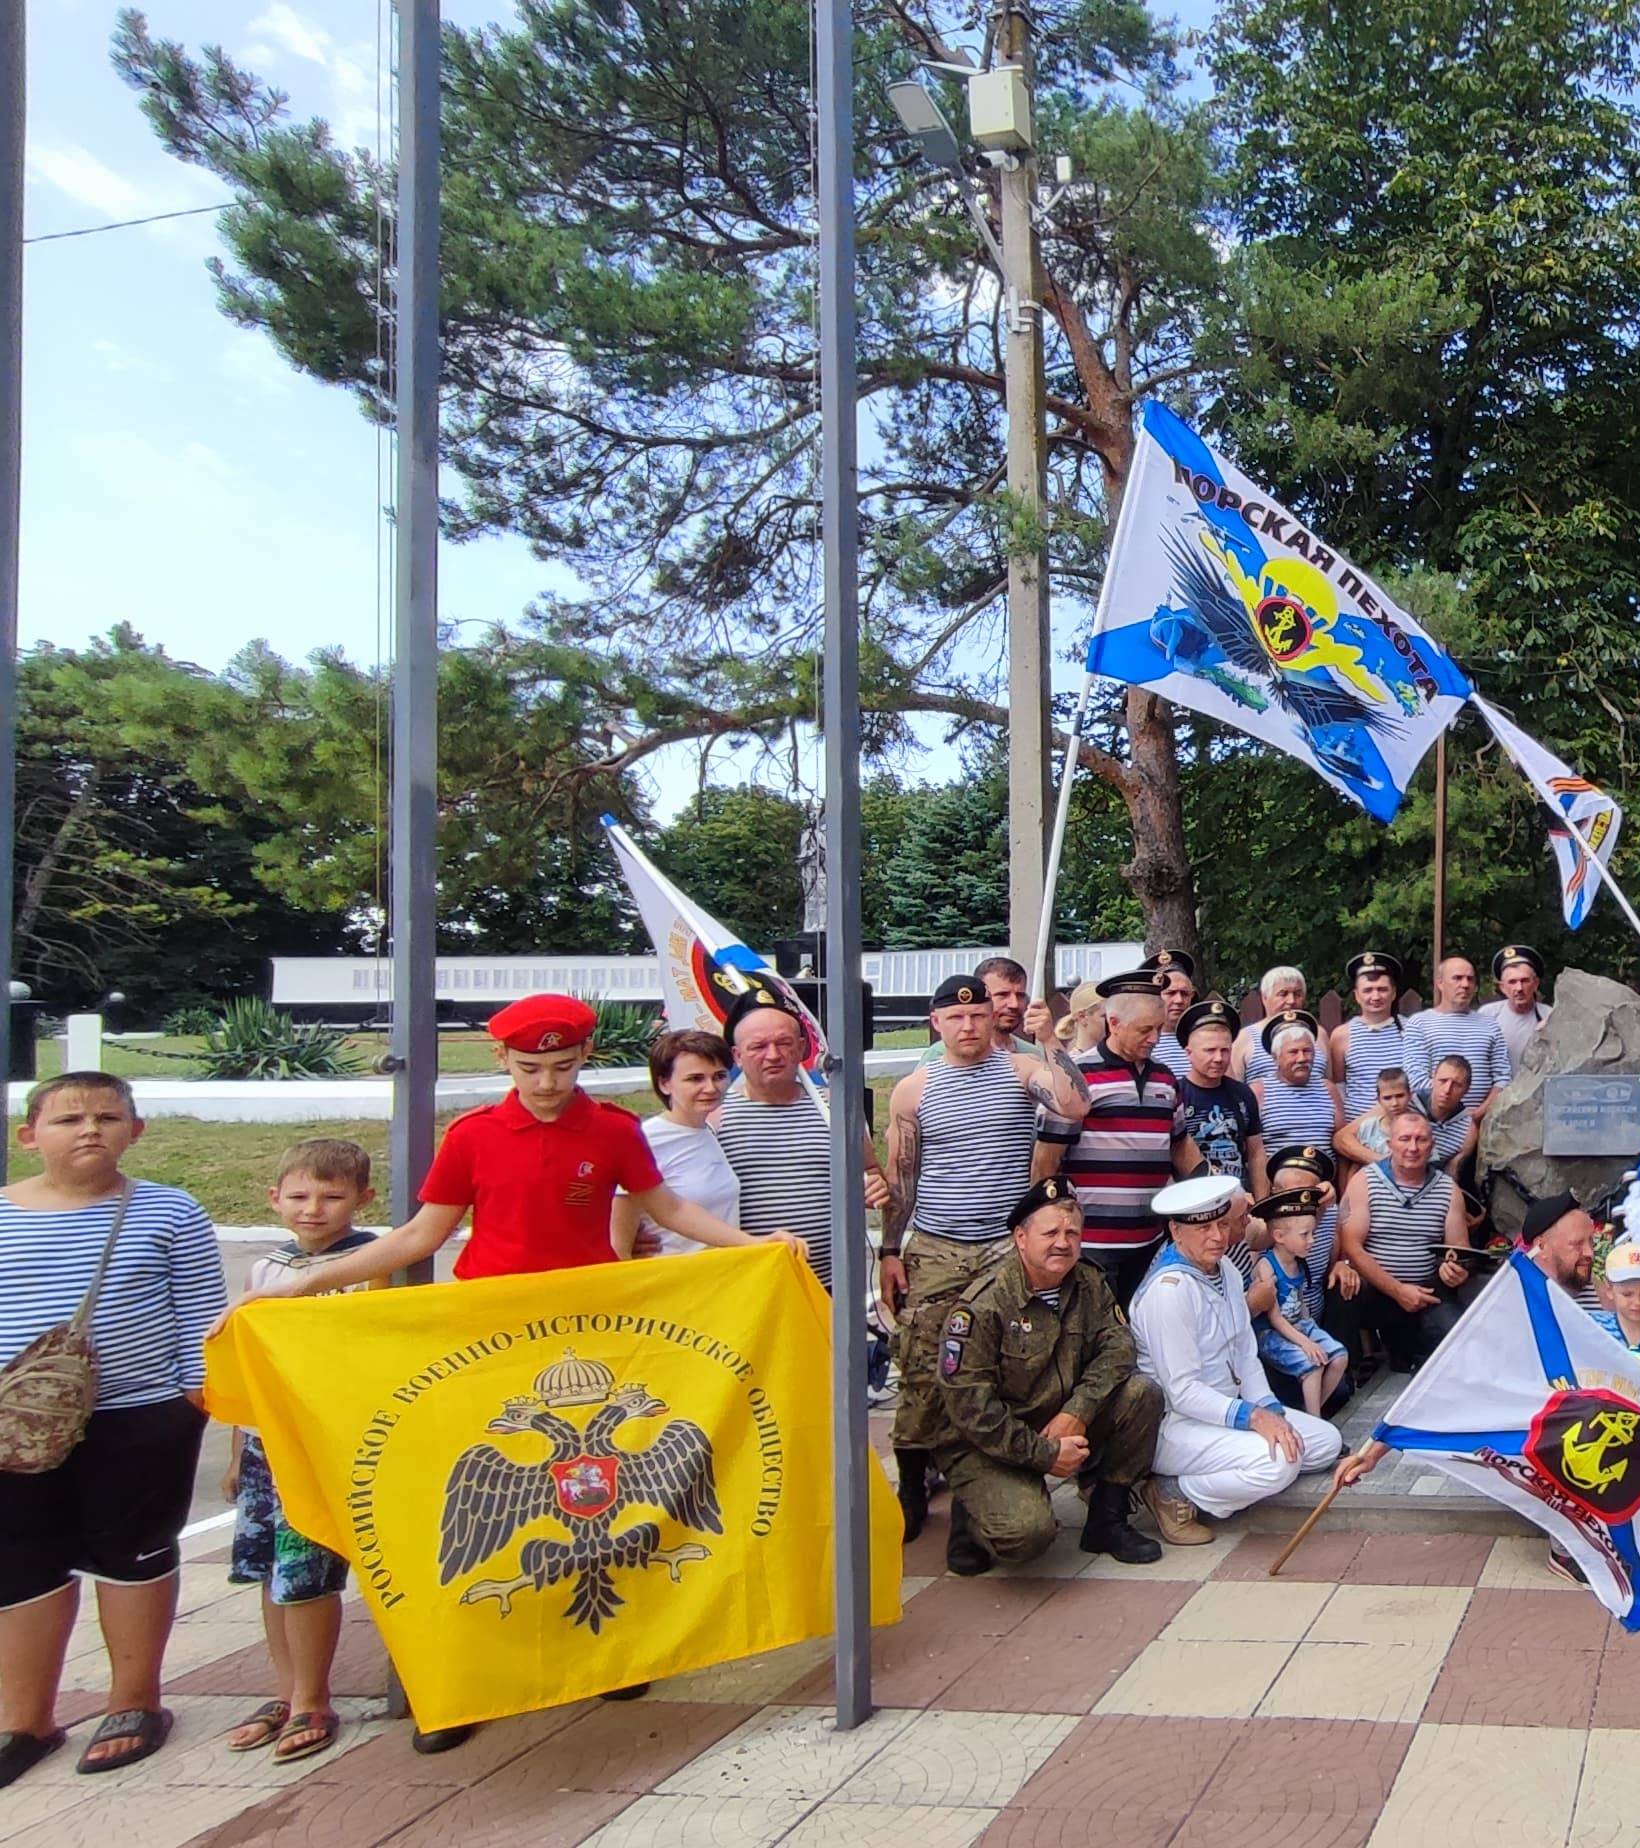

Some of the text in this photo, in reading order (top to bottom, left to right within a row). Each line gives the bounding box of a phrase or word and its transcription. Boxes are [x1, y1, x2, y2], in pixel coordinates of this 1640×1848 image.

[1336, 566, 1438, 704] ПЕХОТА
[346, 1312, 784, 1610] РОССИЙСКОЕ ВОЕННО-ИСТОРИЧЕСКОЕ ОБЩЕСТВО
[1472, 1446, 1569, 1505] МОРСКАЯ
